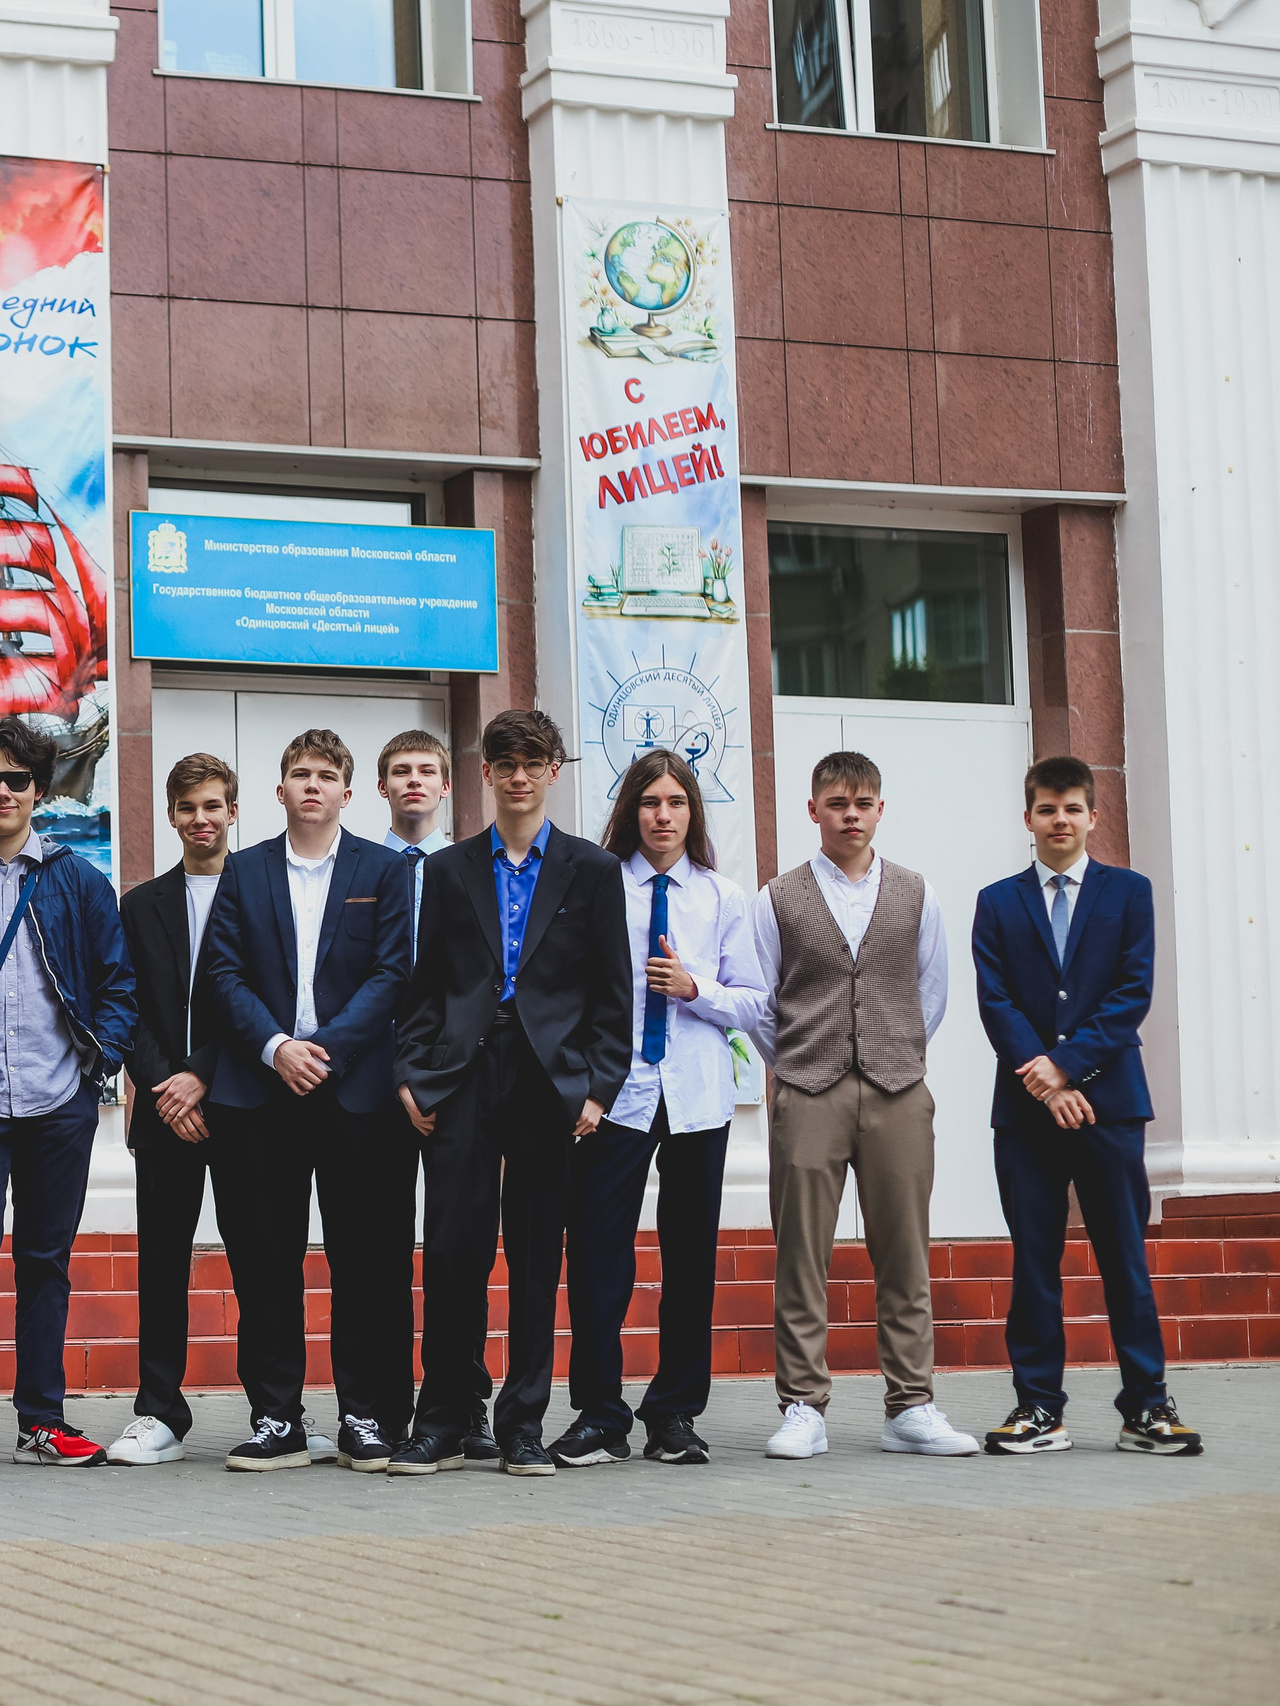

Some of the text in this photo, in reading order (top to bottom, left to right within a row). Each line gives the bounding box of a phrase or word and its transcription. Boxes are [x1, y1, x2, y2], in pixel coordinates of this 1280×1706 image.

[569, 17, 705, 58] 1868-1936
[624, 377, 646, 404] С
[579, 402, 726, 462] ЮБИЛЕЕМ,
[598, 442, 725, 509] ЛИЦЕЙ!
[204, 539, 457, 564] Министерство образования Московской области
[152, 583, 478, 610] Государственное бюджетное общеобразовательное учреждение
[265, 602, 370, 619] Московской области
[235, 616, 400, 635] «Одинцовский «Десятый лицей»
[607, 669, 724, 731] ОДИНЦОВСКИЙ ДЕСЯТЫЙ ЛИЦЕЙ
